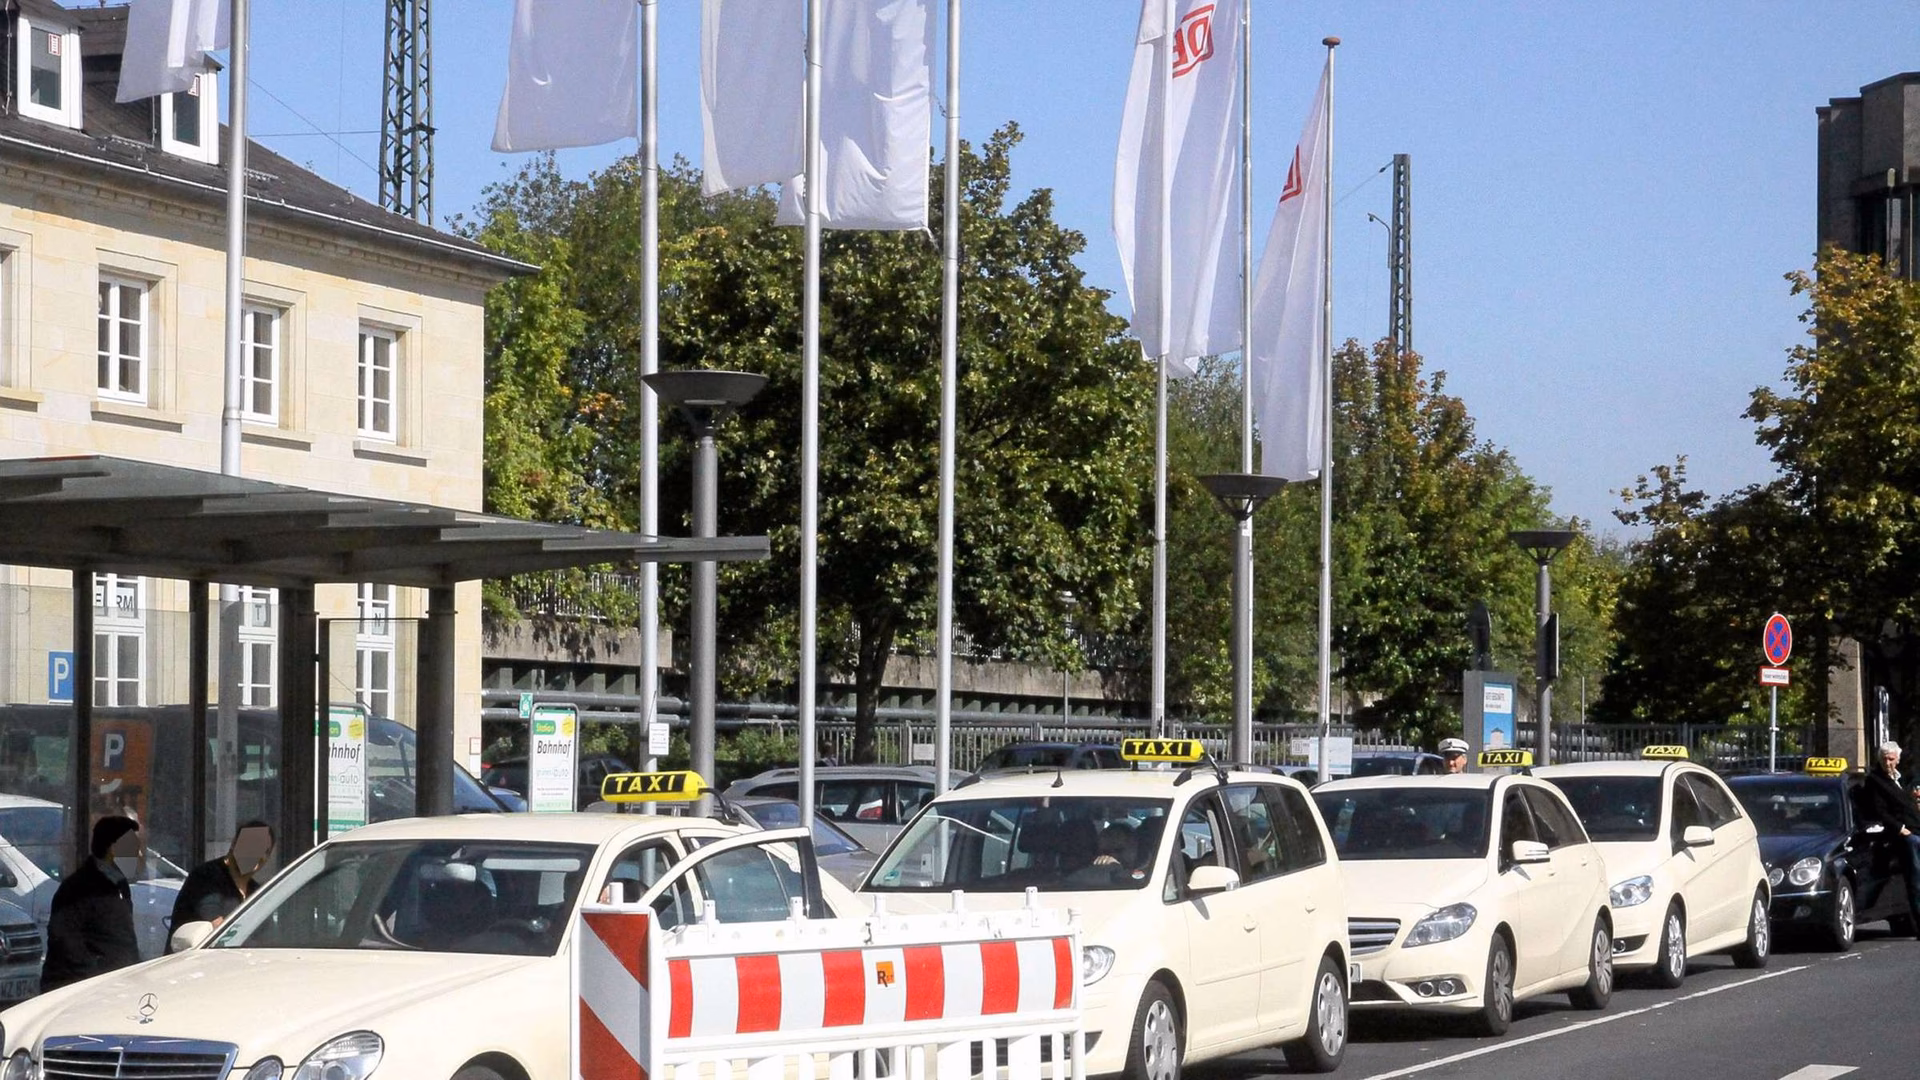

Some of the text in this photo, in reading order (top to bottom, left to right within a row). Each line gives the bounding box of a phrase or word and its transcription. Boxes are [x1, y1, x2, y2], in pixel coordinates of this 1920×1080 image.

[54, 657, 69, 694] P
[104, 733, 125, 768] P
[537, 740, 572, 758] Bahnhof
[1133, 741, 1183, 755] TAXI
[1650, 746, 1681, 754] TAXI
[1486, 753, 1520, 763] TAXI
[1810, 759, 1841, 768] TAXI
[615, 775, 675, 793] TAXI
